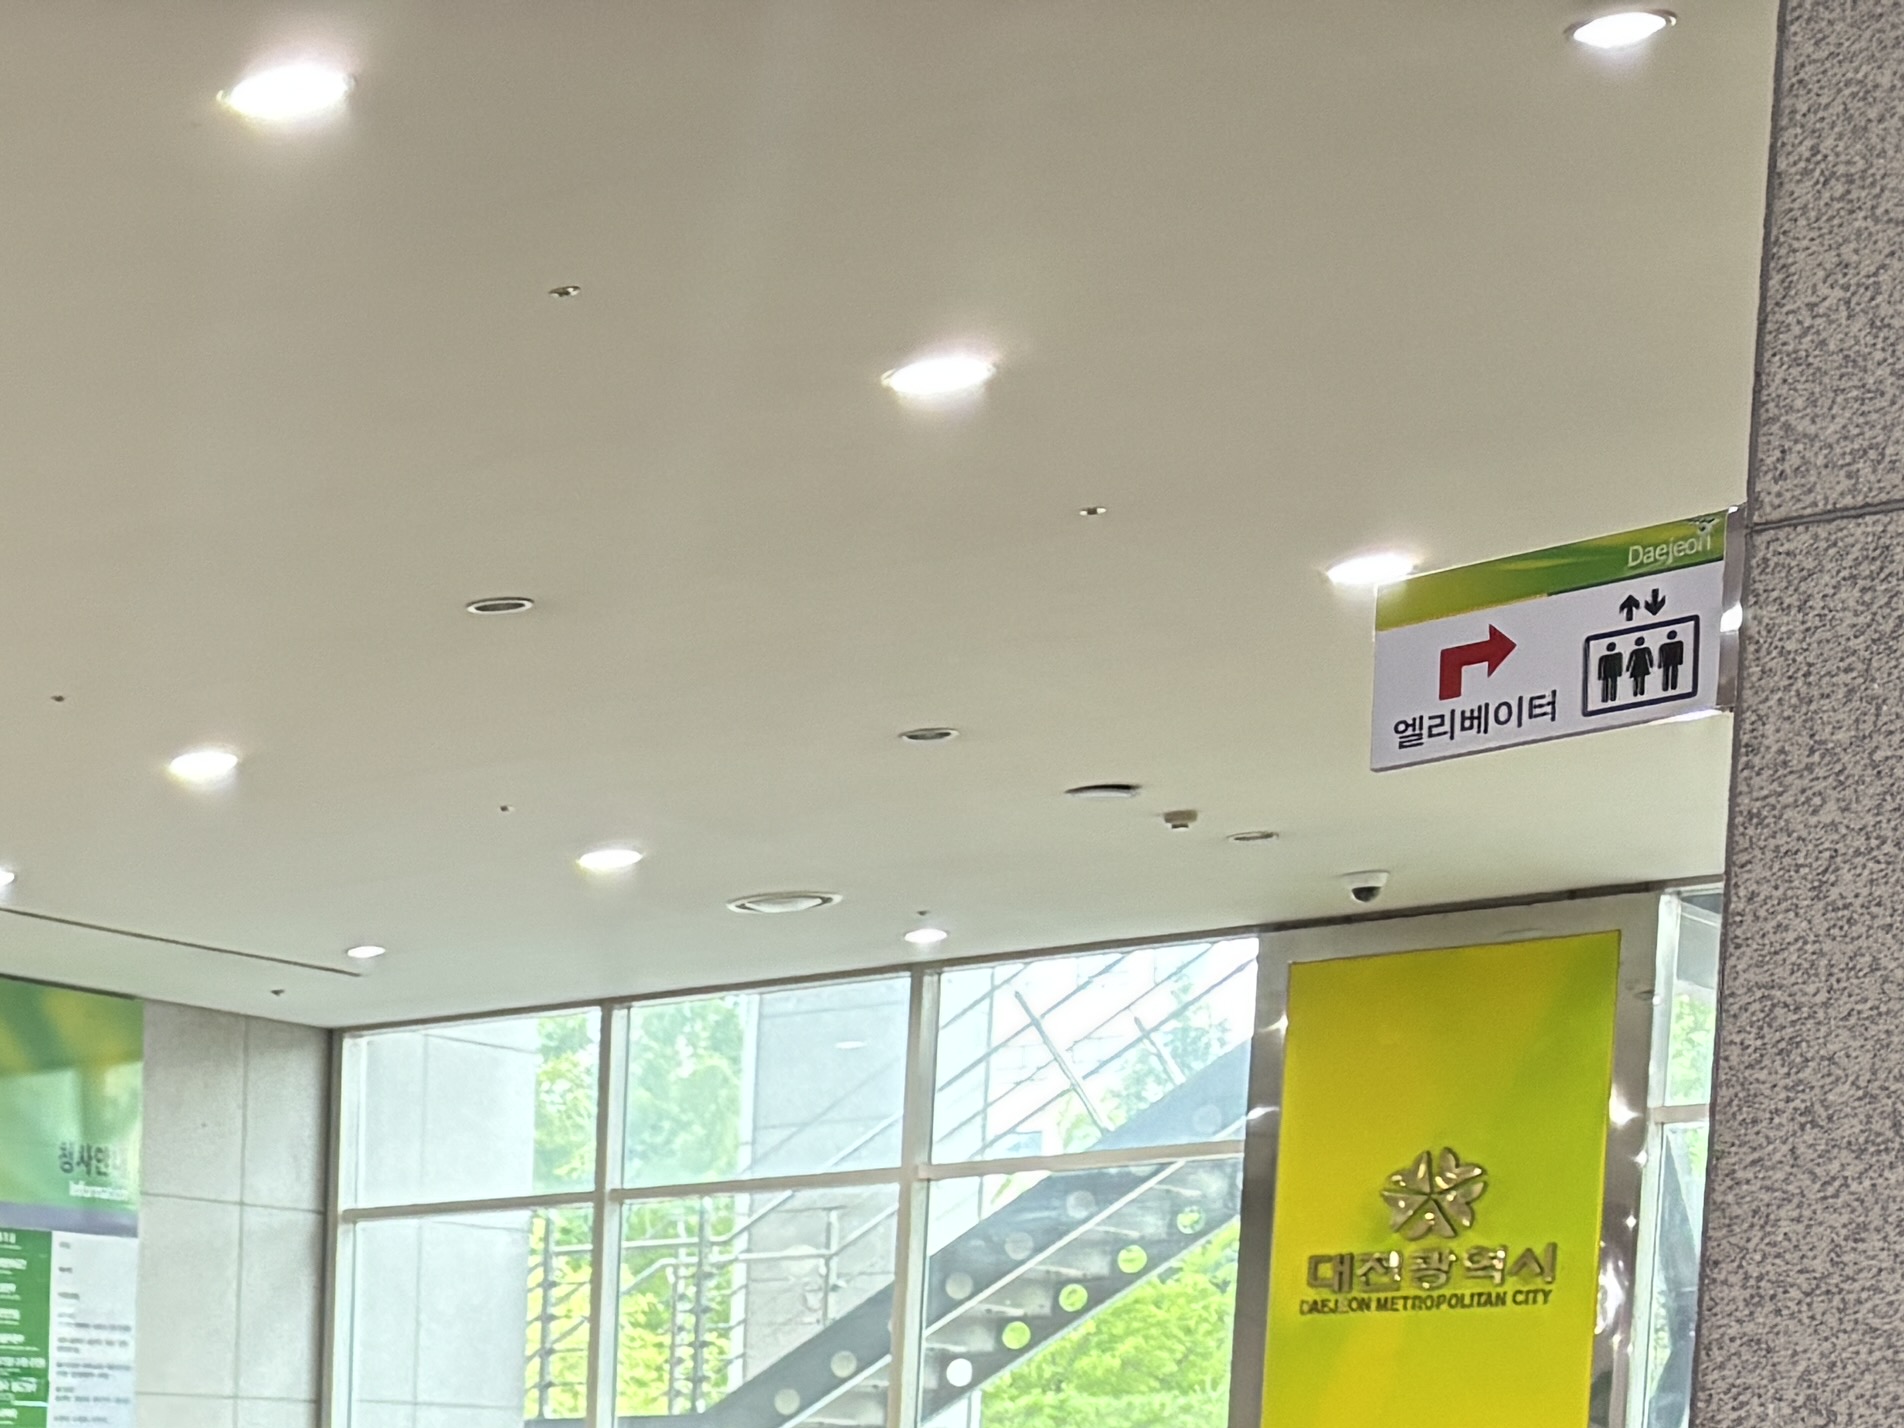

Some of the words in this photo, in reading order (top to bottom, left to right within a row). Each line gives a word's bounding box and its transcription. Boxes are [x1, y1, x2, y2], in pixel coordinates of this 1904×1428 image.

[1627, 533, 1712, 568] Daejeon
[1394, 689, 1557, 750] 엘리베이터
[1306, 1242, 1558, 1293] 대전광역시
[1300, 1297, 1372, 1316] DAEJEON
[1376, 1291, 1507, 1312] METROPOLITAN
[1512, 1288, 1553, 1306] CITY
